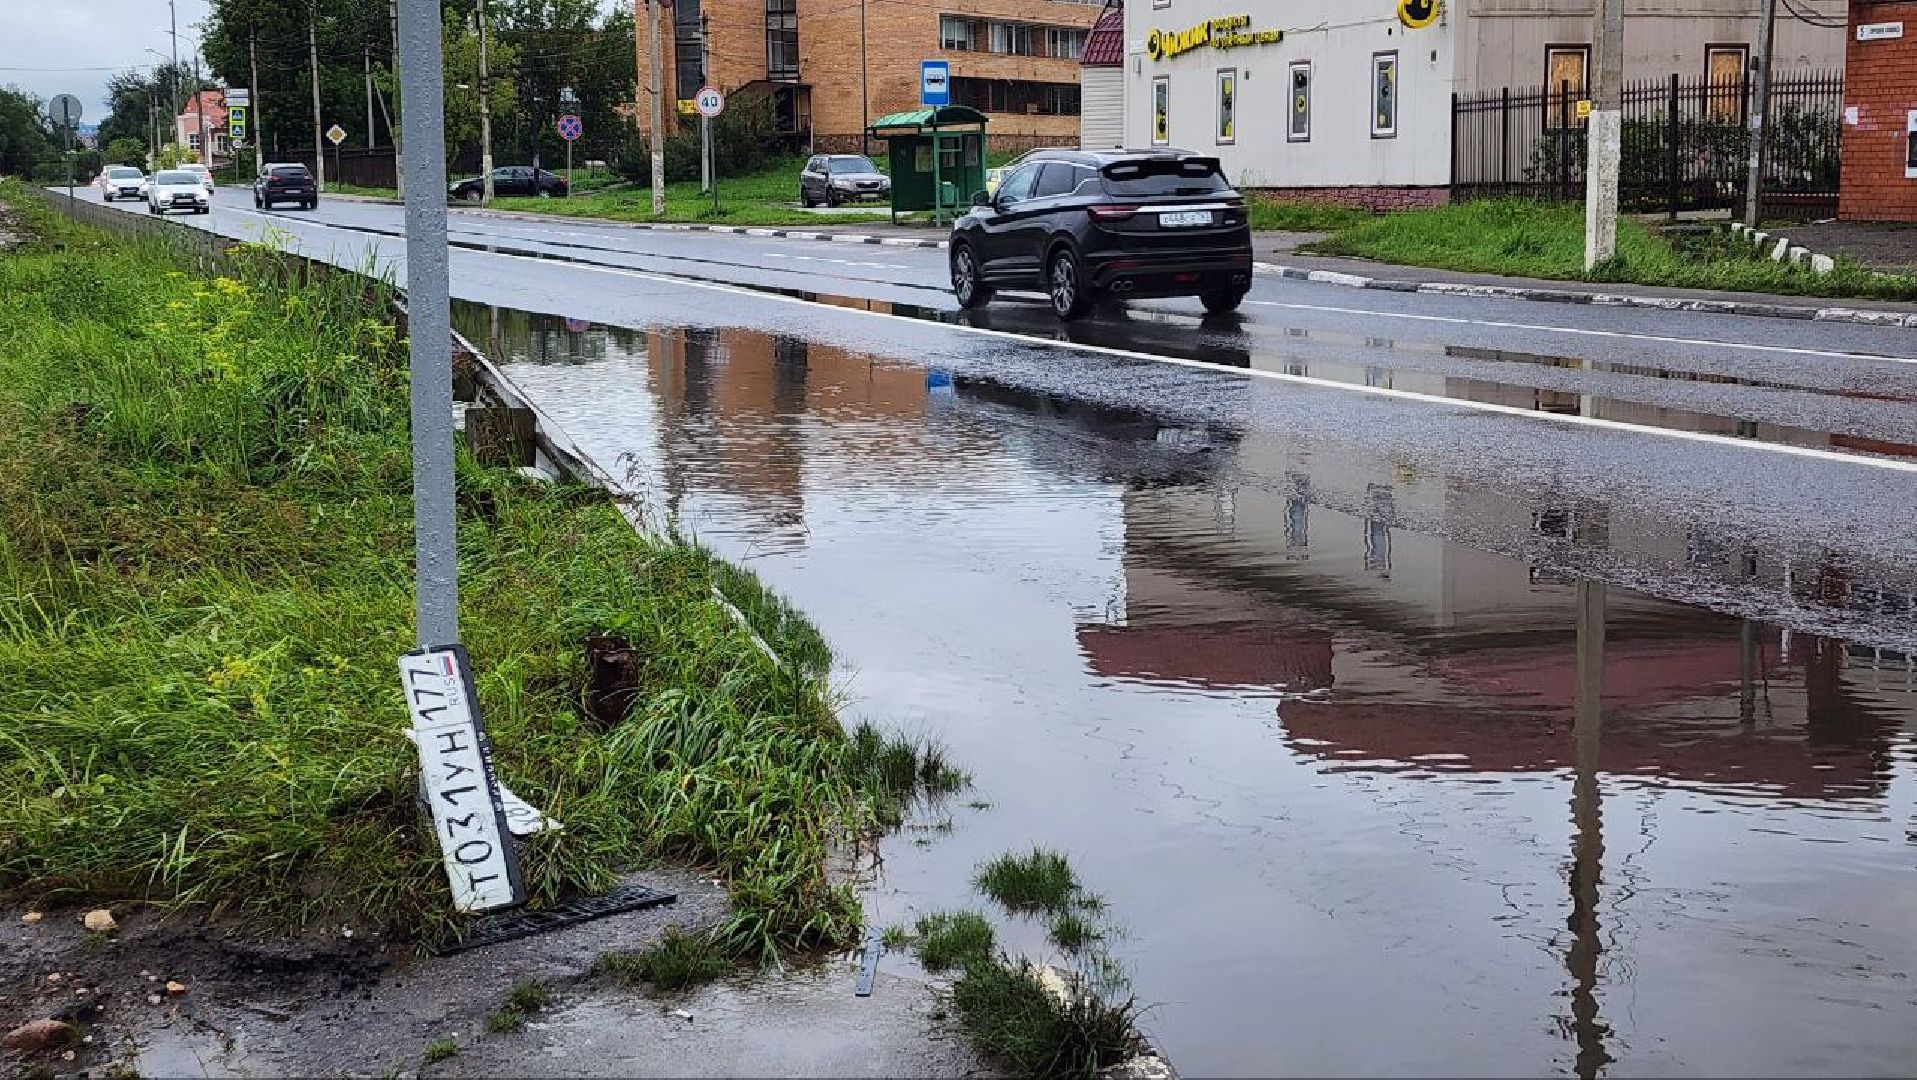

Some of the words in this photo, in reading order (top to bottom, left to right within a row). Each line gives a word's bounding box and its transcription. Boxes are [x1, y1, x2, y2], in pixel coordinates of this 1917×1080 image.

[701, 96, 718, 107] 40
[408, 668, 448, 721] 177
[444, 678, 459, 706] RUS
